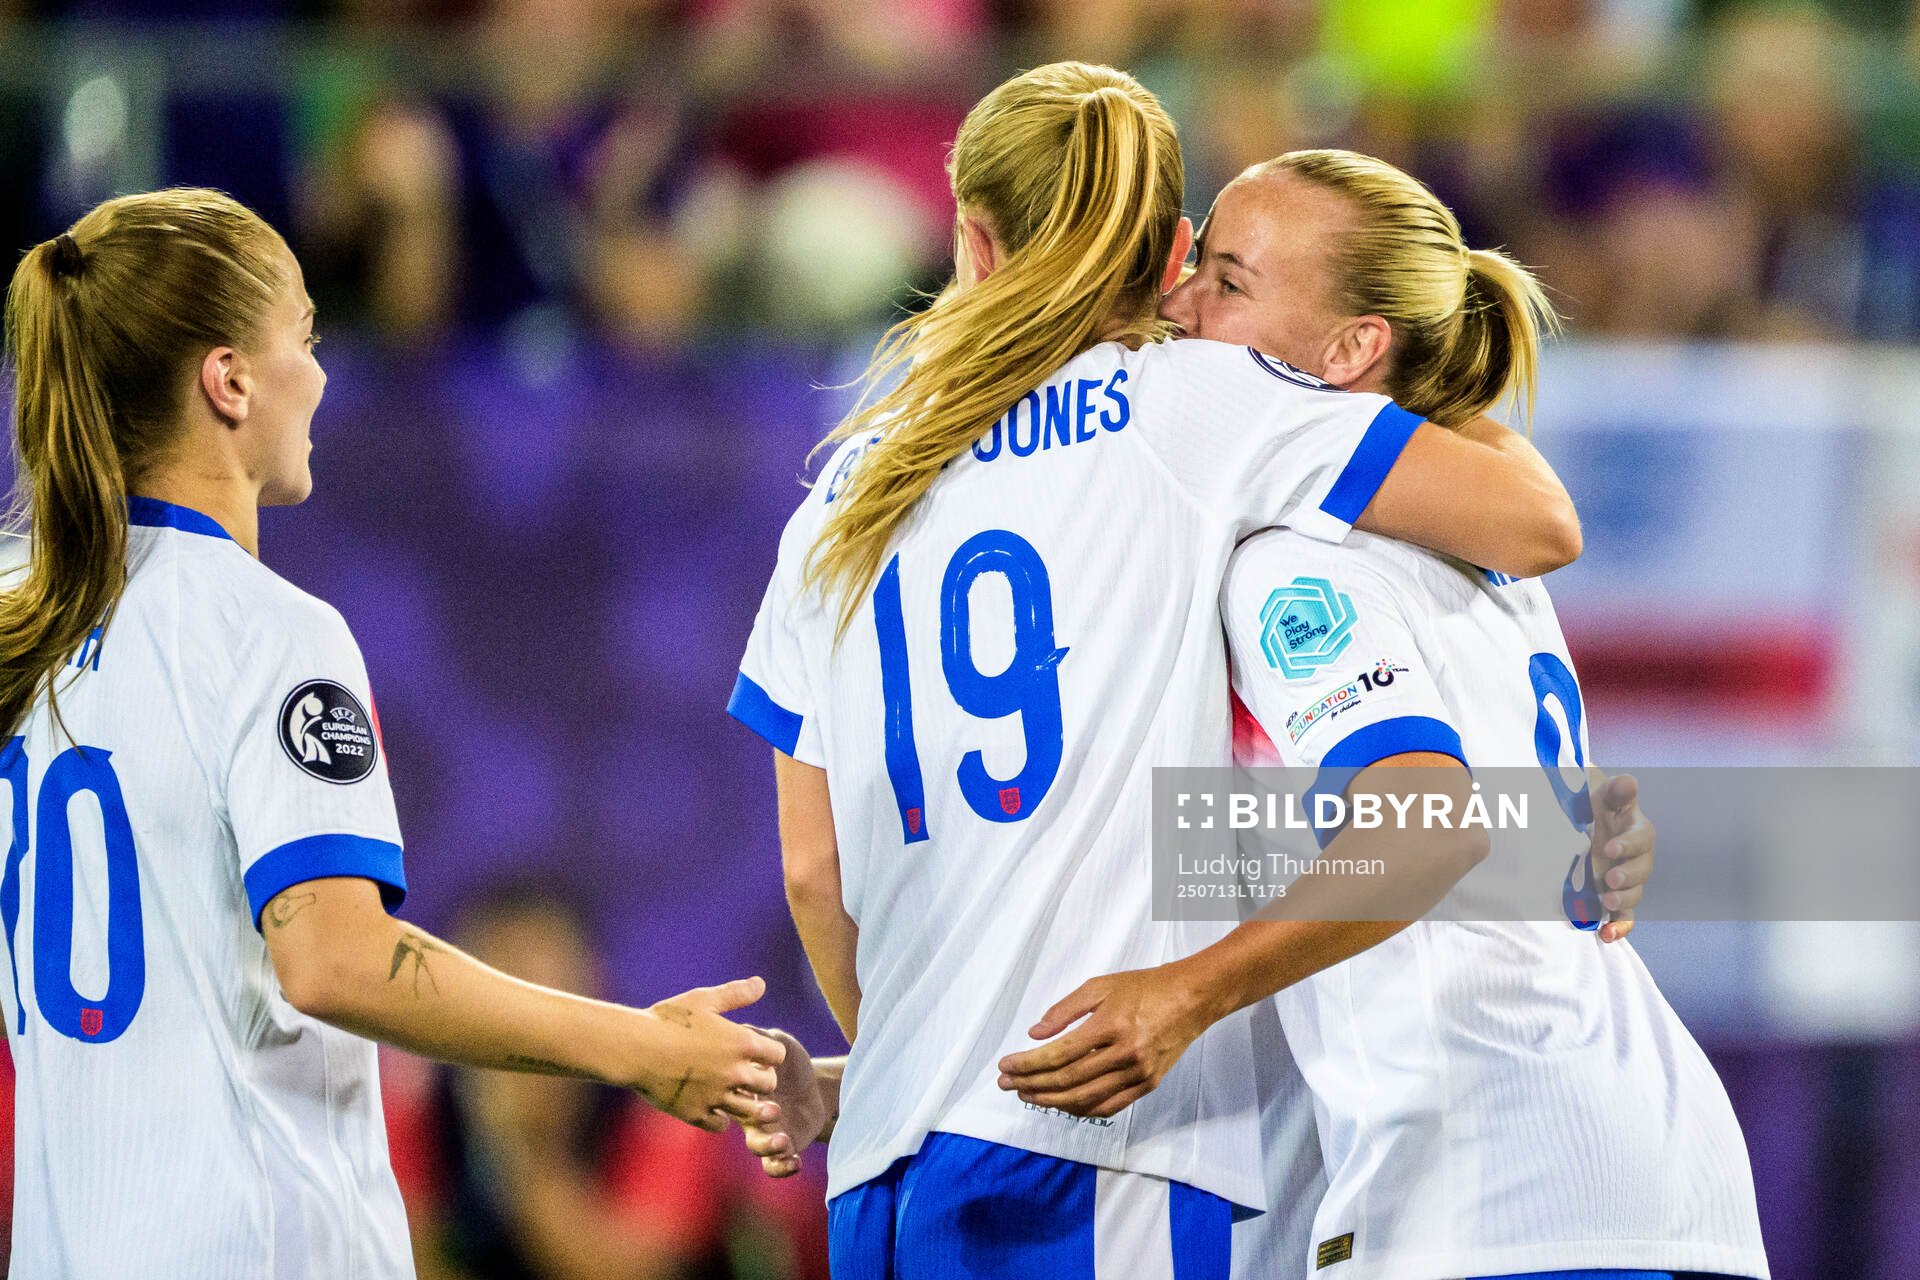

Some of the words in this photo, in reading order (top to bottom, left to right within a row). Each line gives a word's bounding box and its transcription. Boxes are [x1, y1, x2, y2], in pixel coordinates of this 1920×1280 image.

[1280, 614, 1298, 628] We
[1285, 620, 1310, 639] Play
[1289, 625, 1328, 650] Strong
[872, 529, 1071, 846] 19
[1357, 668, 1395, 693] 10
[331, 708, 356, 722] UEFA
[1289, 685, 1358, 742] FOUNDATION
[321, 722, 368, 737] EUROPEAN
[321, 731, 372, 746] CHAMPIONS
[335, 743, 365, 757] 2022
